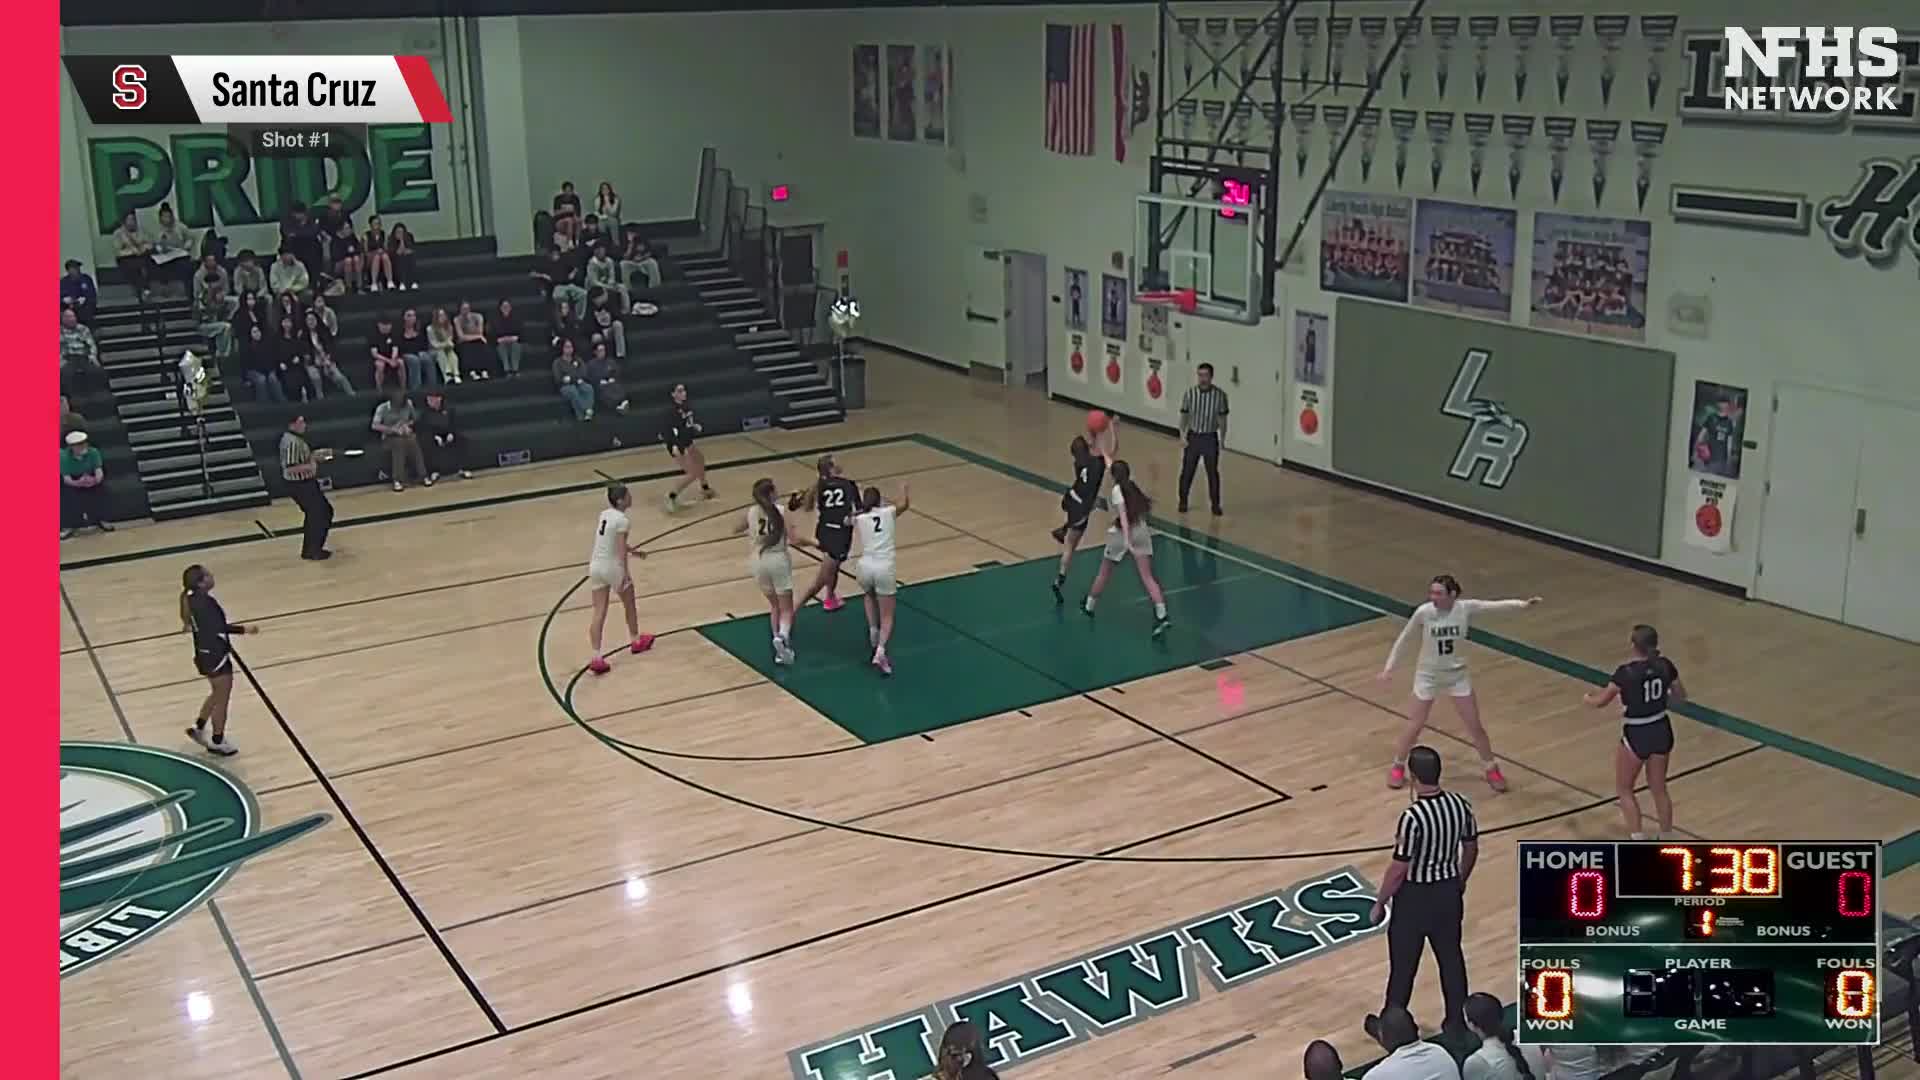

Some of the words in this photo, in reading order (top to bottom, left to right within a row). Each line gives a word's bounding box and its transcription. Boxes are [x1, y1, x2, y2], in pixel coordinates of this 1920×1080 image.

[88, 121, 440, 234] PRIDE
[823, 488, 845, 507] 22
[872, 516, 883, 532] 2
[1438, 640, 1454, 656] 15
[1643, 678, 1664, 703] 10
[1526, 851, 1604, 869] HOME
[1787, 851, 1873, 869] GUEST
[1659, 847, 1777, 894] 7:38
[1570, 872, 1603, 917] 0
[1674, 897, 1726, 907] PERIOD
[1839, 872, 1871, 917] 0
[1585, 925, 1641, 937] BONUS
[1756, 925, 1811, 937] BONUS
[1521, 958, 1581, 969] FOULS
[1664, 958, 1732, 969] PLAYER
[1816, 958, 1876, 969] FOULS
[801, 870, 1390, 1080] HAWKS
[1536, 970, 1571, 1018] 0
[1526, 1019, 1574, 1030] WON
[1674, 1018, 1727, 1029] GAME
[1824, 1018, 1873, 1029] WON
